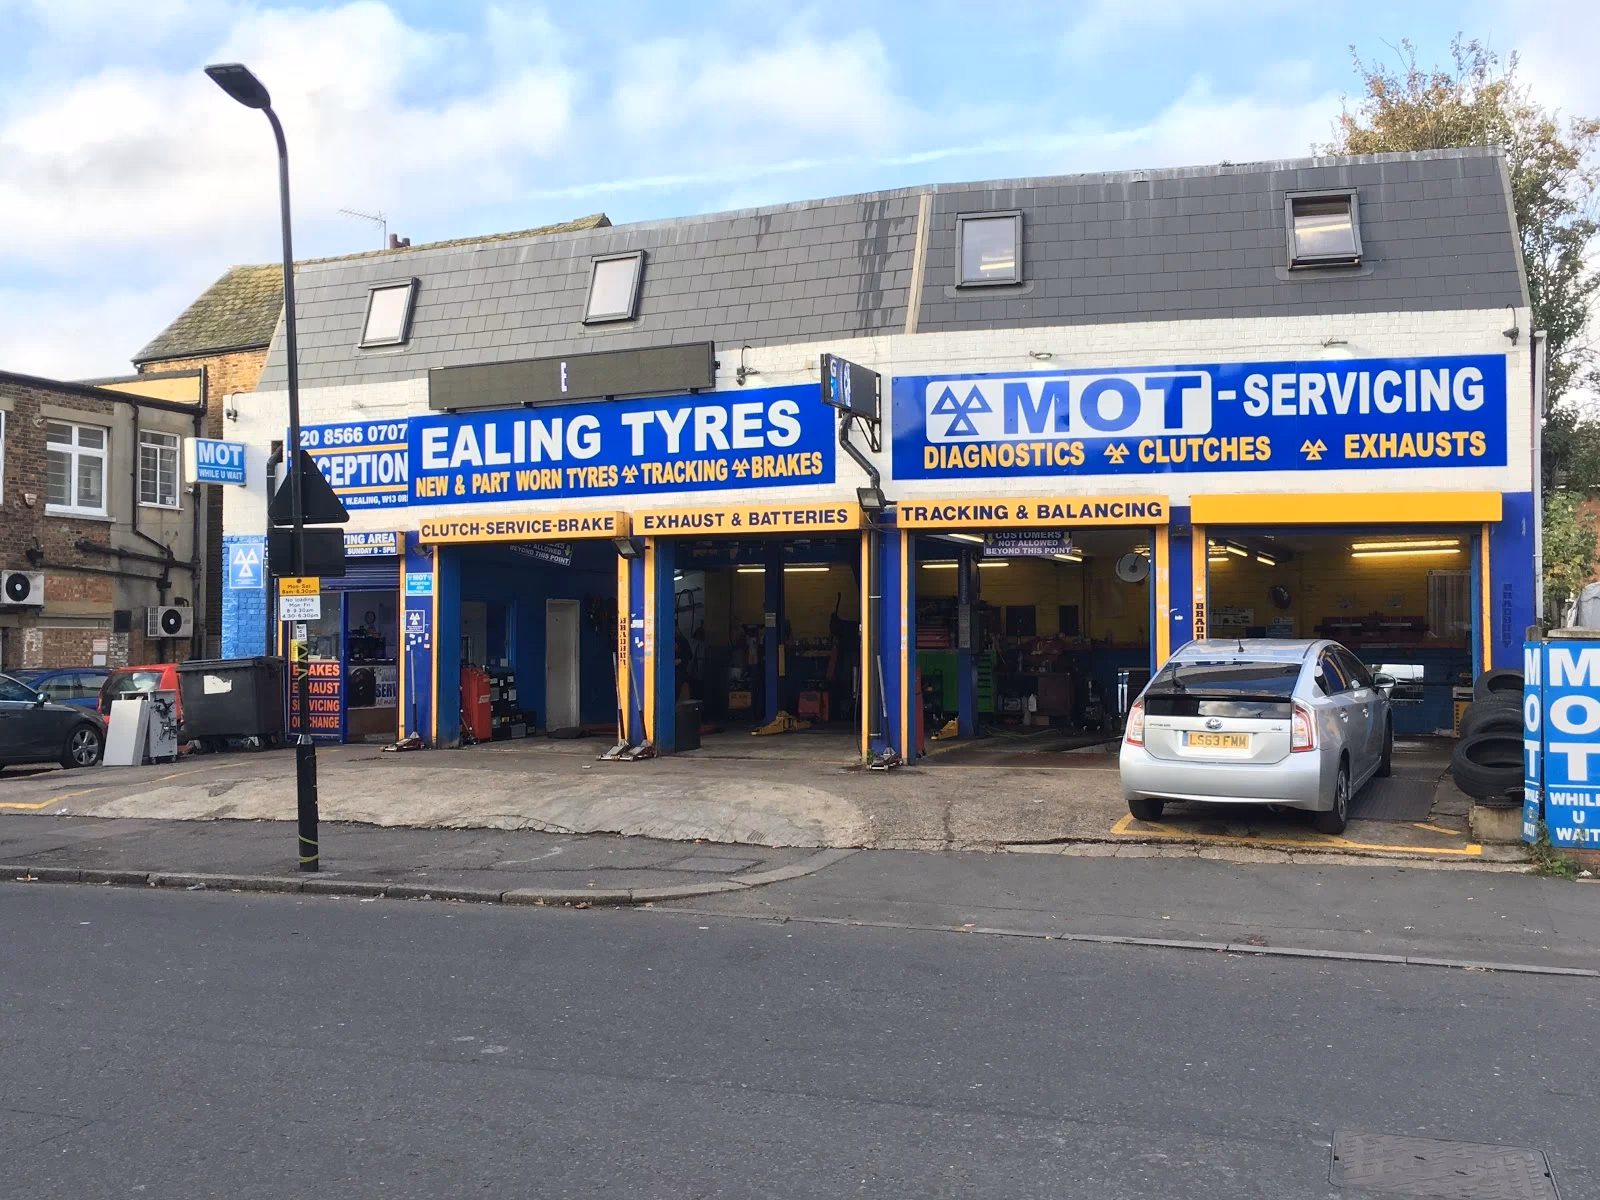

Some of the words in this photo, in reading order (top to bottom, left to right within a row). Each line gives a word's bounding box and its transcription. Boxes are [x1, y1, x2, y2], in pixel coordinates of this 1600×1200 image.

[1003, 374, 1202, 436] MOT
[300, 430, 319, 447] 20
[324, 426, 364, 445] 8566
[367, 423, 408, 442] 0707
[422, 414, 601, 470] EALING
[621, 400, 802, 457] TYRES
[198, 442, 243, 466] MOT
[923, 441, 1085, 470] DIAGNOSTICS
[1138, 436, 1272, 464] CLUTCHES
[1344, 430, 1487, 459] EXHAUSTS
[199, 469, 220, 479] WHILE
[221, 470, 226, 479] U
[227, 471, 243, 480] WAIT
[312, 452, 408, 487] CEPTION
[416, 476, 449, 498] NEW
[454, 474, 466, 496] &
[472, 471, 511, 494] PART
[516, 468, 563, 492] WORN
[567, 465, 619, 488] TYRES
[641, 458, 728, 485] TRACKING
[751, 451, 823, 479] BRAKES
[382, 494, 397, 504] W13
[644, 512, 725, 529] EXHAUST
[731, 513, 742, 527] &
[749, 508, 849, 527] BATTERIES
[901, 504, 1008, 523] TRACKING
[1015, 504, 1029, 520] &
[1036, 501, 1162, 519] BALANCING
[367, 532, 396, 544] AREA
[995, 531, 1062, 539] CUSTOMERS
[1018, 539, 1059, 547] ALLOWED
[347, 546, 373, 555] SUNDAY
[382, 546, 396, 554] 5PM
[535, 550, 549, 560] THIS
[550, 554, 570, 565] POINT
[985, 547, 1020, 555] BEYOND
[292, 664, 340, 676] BAKES
[291, 682, 340, 694] EHAUST
[291, 699, 340, 712] SVICING
[1189, 734, 1220, 746] LS63
[1572, 810, 1585, 824] U
[1556, 827, 1600, 842] WAIT
